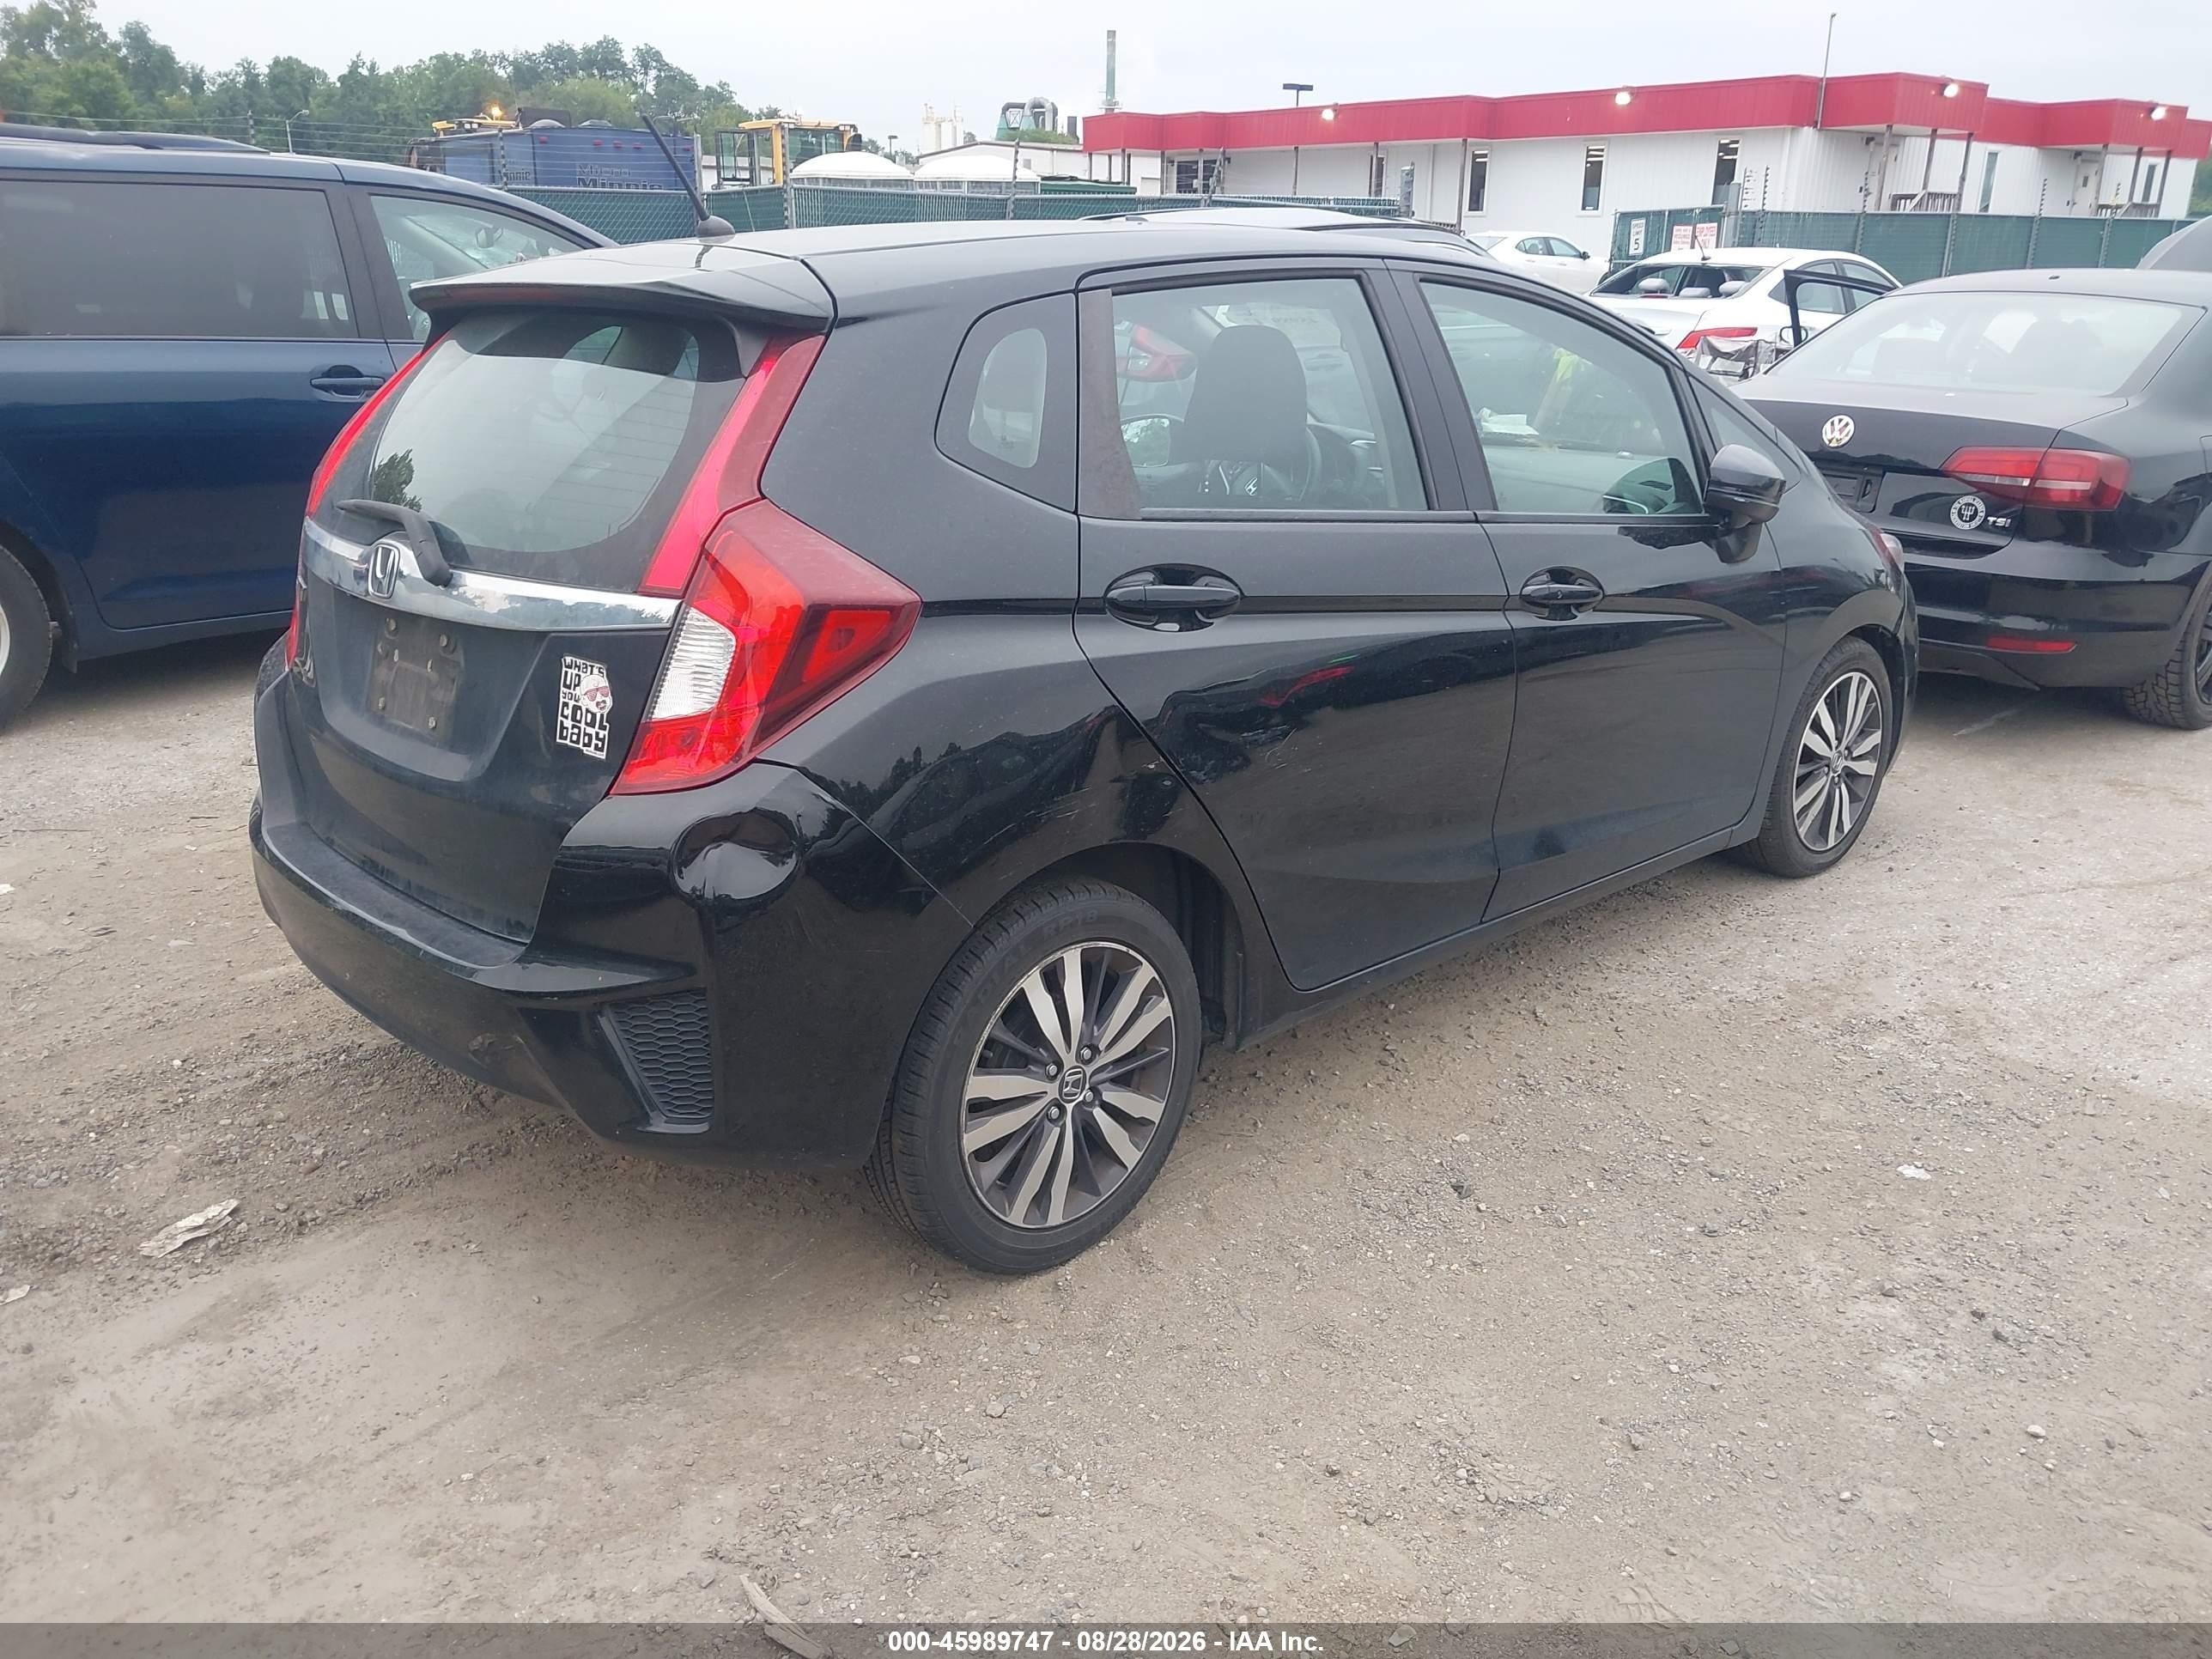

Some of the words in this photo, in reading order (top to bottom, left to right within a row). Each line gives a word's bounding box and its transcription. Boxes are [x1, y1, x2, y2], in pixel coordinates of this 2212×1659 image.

[1633, 238, 1640, 251] 5
[1987, 516, 2011, 528] TSI
[562, 670, 580, 690] UP
[561, 701, 607, 732] COOL
